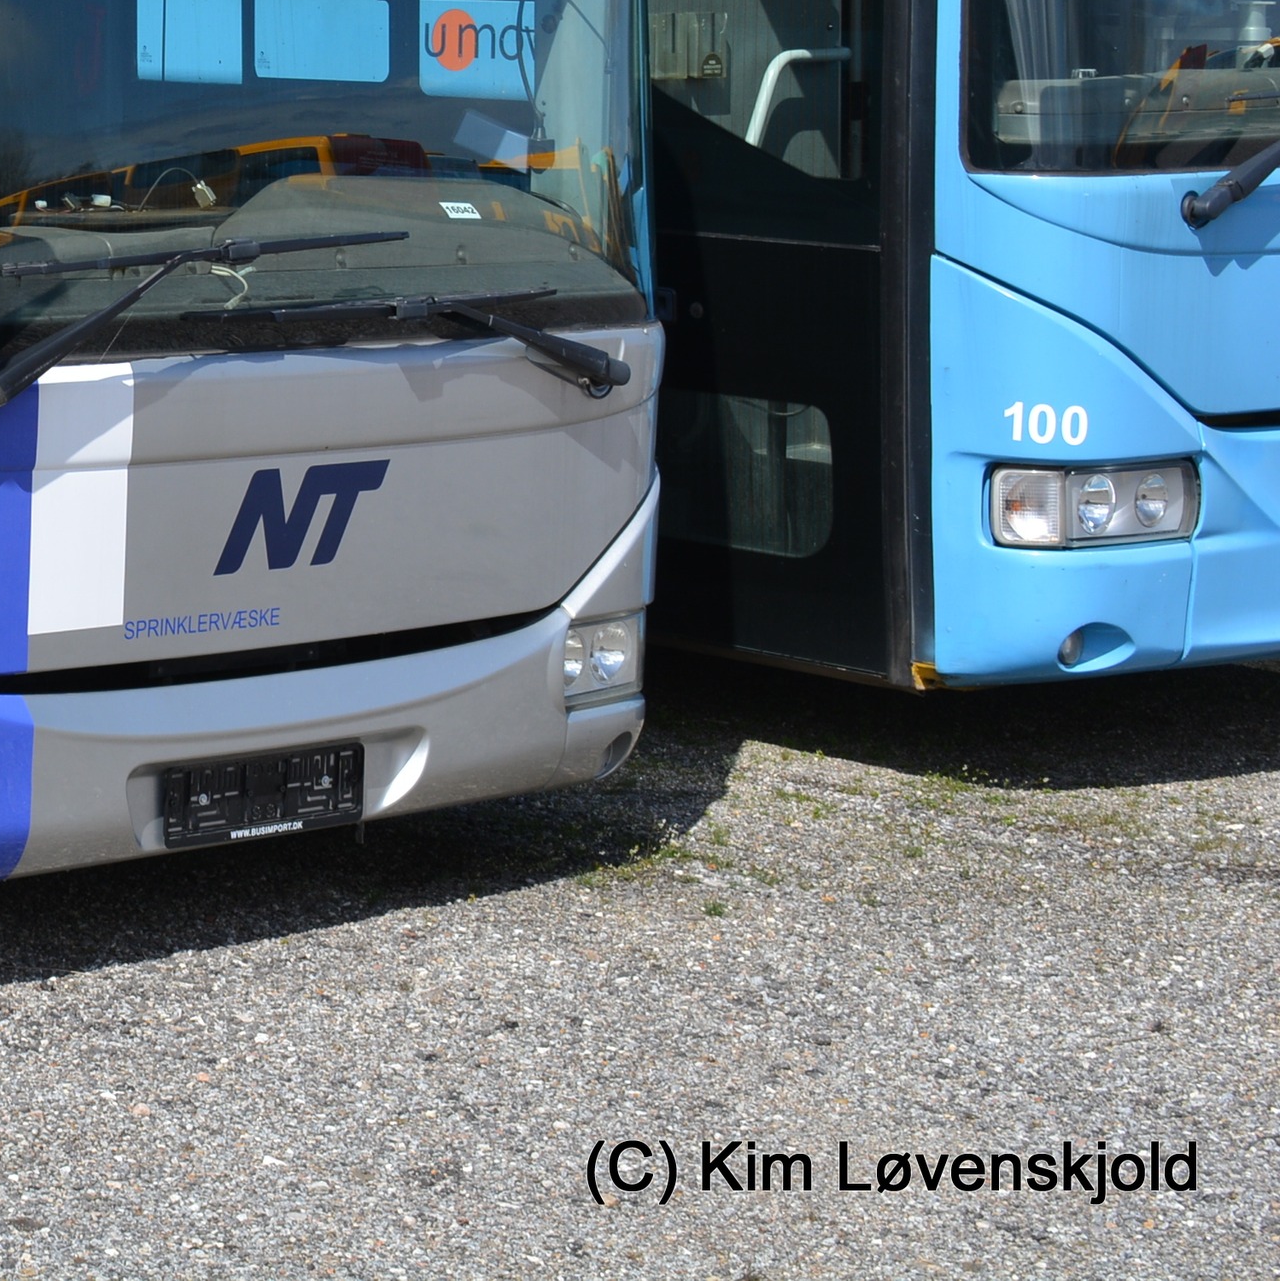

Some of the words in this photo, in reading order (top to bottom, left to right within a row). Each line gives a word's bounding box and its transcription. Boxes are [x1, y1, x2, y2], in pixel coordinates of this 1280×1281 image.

[445, 205, 477, 215] 16042
[1003, 401, 1089, 446] 100
[213, 459, 391, 576] NT
[124, 607, 281, 640] SPRINKLERVÆSKE
[230, 821, 303, 839] WWW.BUSIMPORT.DK
